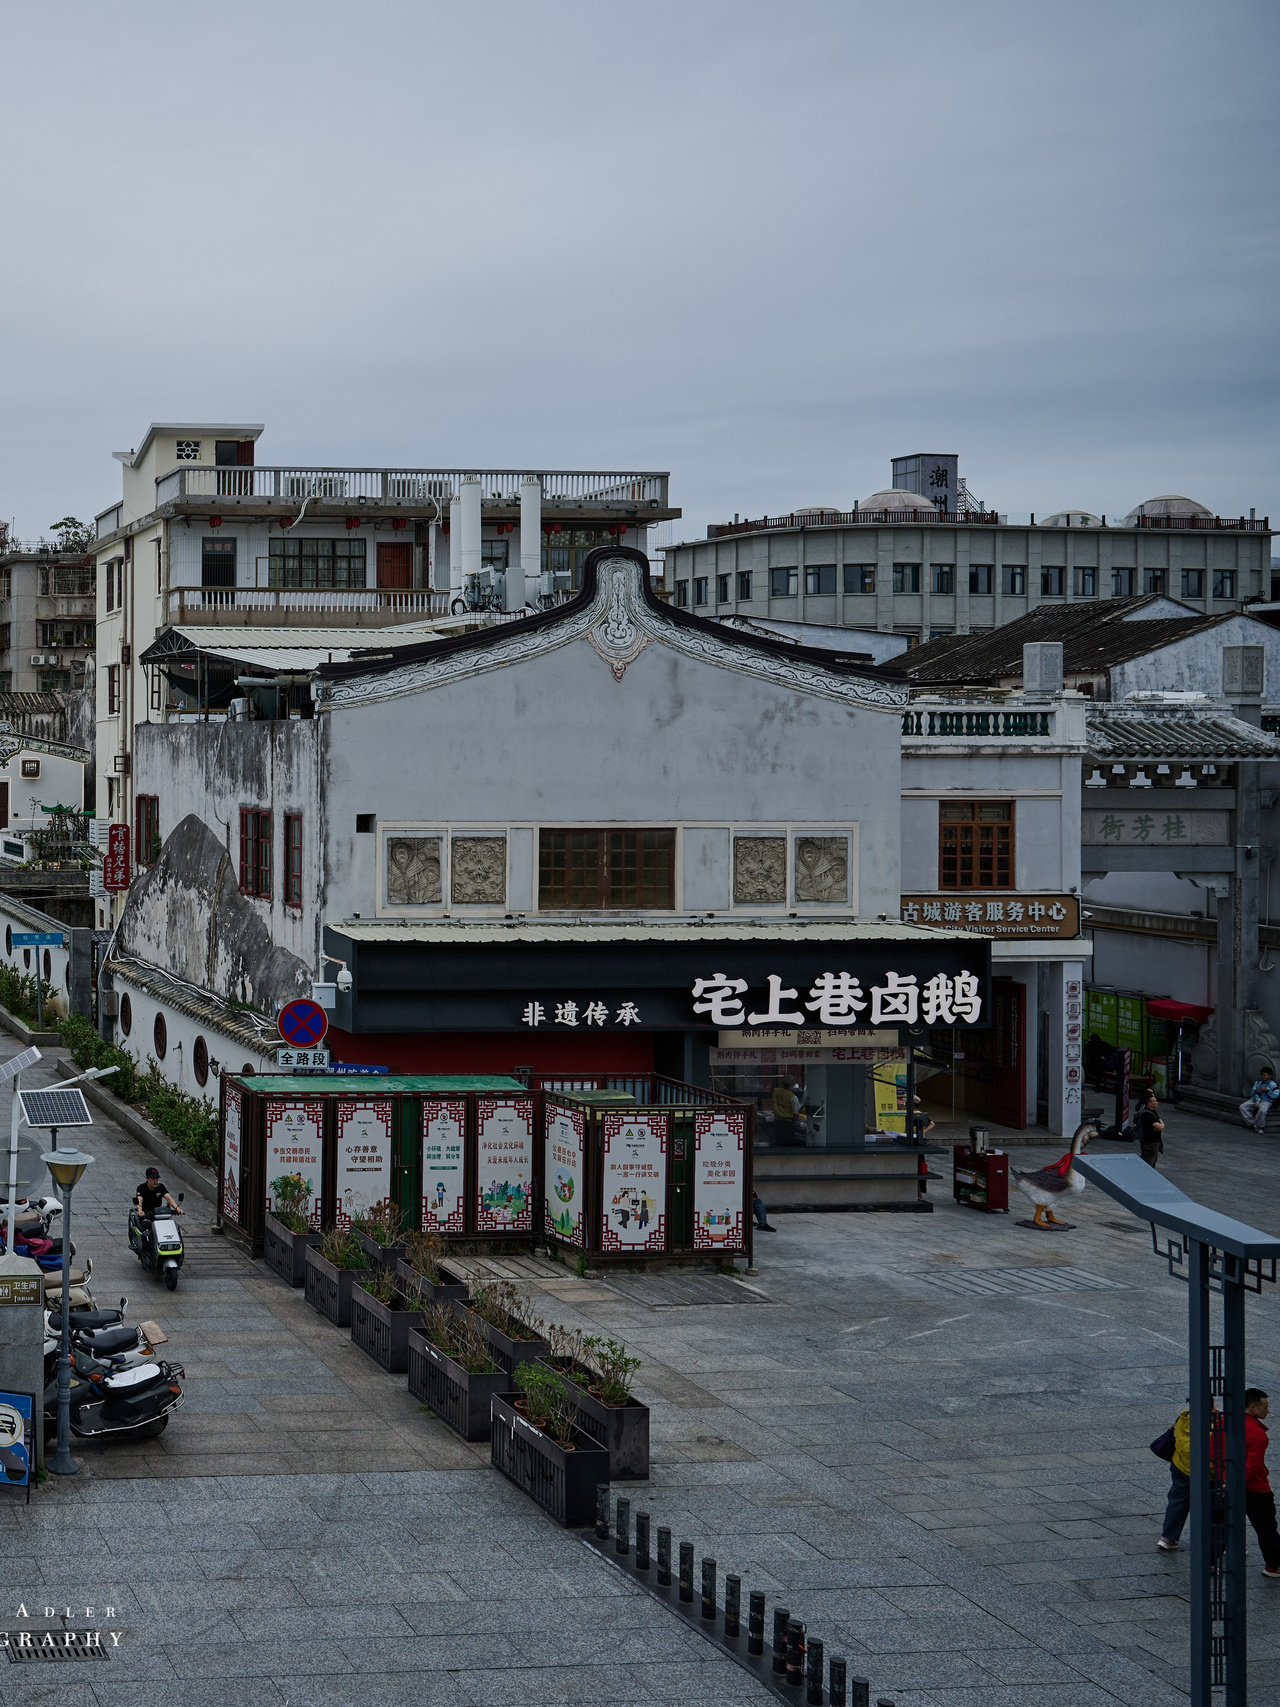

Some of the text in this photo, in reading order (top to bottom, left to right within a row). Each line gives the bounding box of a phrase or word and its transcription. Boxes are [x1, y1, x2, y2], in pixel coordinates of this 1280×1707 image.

[902, 901, 1067, 922] 古城游客服务中心
[966, 925, 995, 933] Visitor
[996, 925, 1028, 933] Service
[1030, 925, 1060, 933] Center
[691, 969, 983, 1026] 宅上巷卤鹅
[521, 1000, 642, 1027] 非遗传承
[827, 1029, 876, 1037] 扫码带回家
[781, 1050, 821, 1059] 扫码带回家
[832, 1047, 905, 1060] 宅上巷卤鹅
[281, 1052, 325, 1065] 全路段
[345, 1145, 378, 1153] 心存善意
[482, 1141, 524, 1150] 净化社会文化环境
[273, 1147, 311, 1155] 争当文明市民
[351, 1155, 383, 1163] 守望相助
[487, 1155, 529, 1164] 关爱未成年人成长
[610, 1163, 653, 1171] 做人做事守诚信
[702, 1160, 731, 1168] 垃圾分类
[707, 1170, 736, 1178] 美化家园
[13, 1281, 37, 1290] 卫生间
